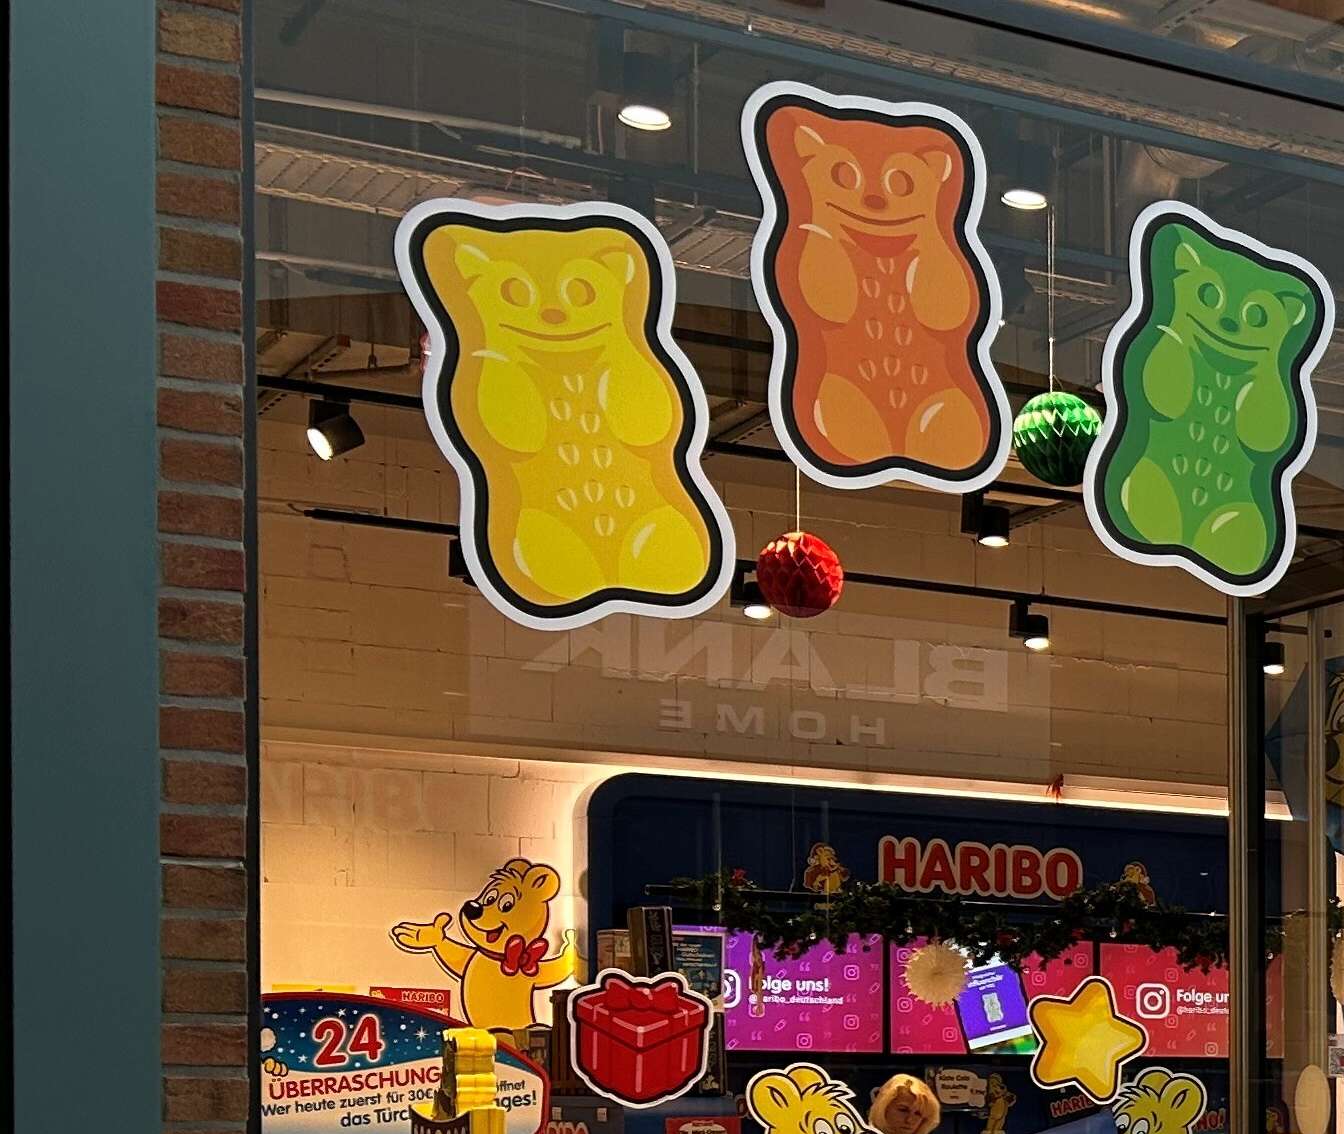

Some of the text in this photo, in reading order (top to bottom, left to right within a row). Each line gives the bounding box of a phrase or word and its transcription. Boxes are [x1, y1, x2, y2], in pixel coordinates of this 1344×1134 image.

[882, 838, 1080, 897] HARIBO
[749, 975, 830, 994] olge uns!
[402, 991, 444, 1003] HARIBO
[1176, 988, 1212, 1006] Folge
[313, 1015, 384, 1067] 24
[261, 1102, 292, 1117] Wer
[294, 1097, 337, 1114] heute
[339, 1092, 381, 1108] zuerst
[386, 1090, 405, 1104] für
[340, 1112, 371, 1128] das
